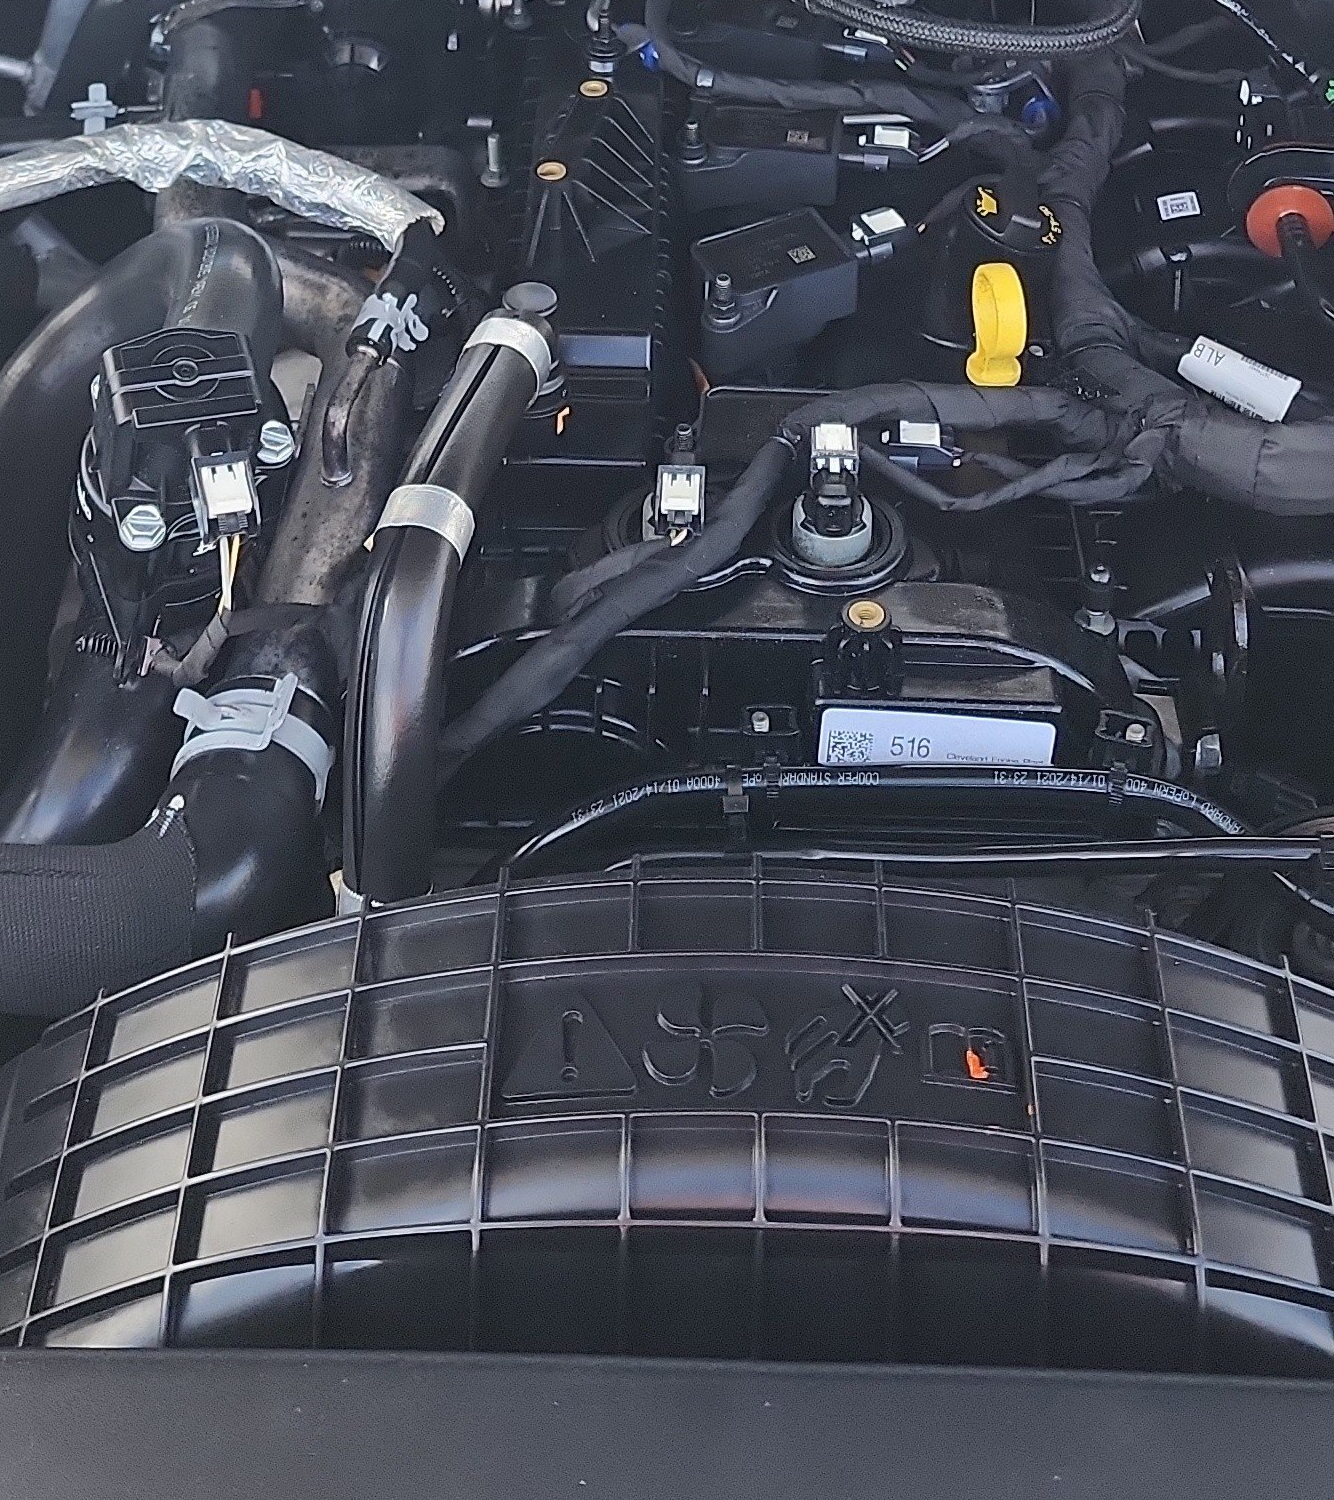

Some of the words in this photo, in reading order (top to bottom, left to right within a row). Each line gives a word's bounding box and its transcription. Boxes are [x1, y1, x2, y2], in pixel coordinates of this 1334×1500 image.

[1193, 343, 1226, 367] ALB
[889, 735, 931, 759] 516
[780, 772, 832, 786] STANDAR
[838, 772, 880, 786] COOPER
[992, 770, 1028, 784] 23:31
[1036, 771, 1107, 788] 01/14/2021
[612, 778, 680, 806] 01/14/2021
